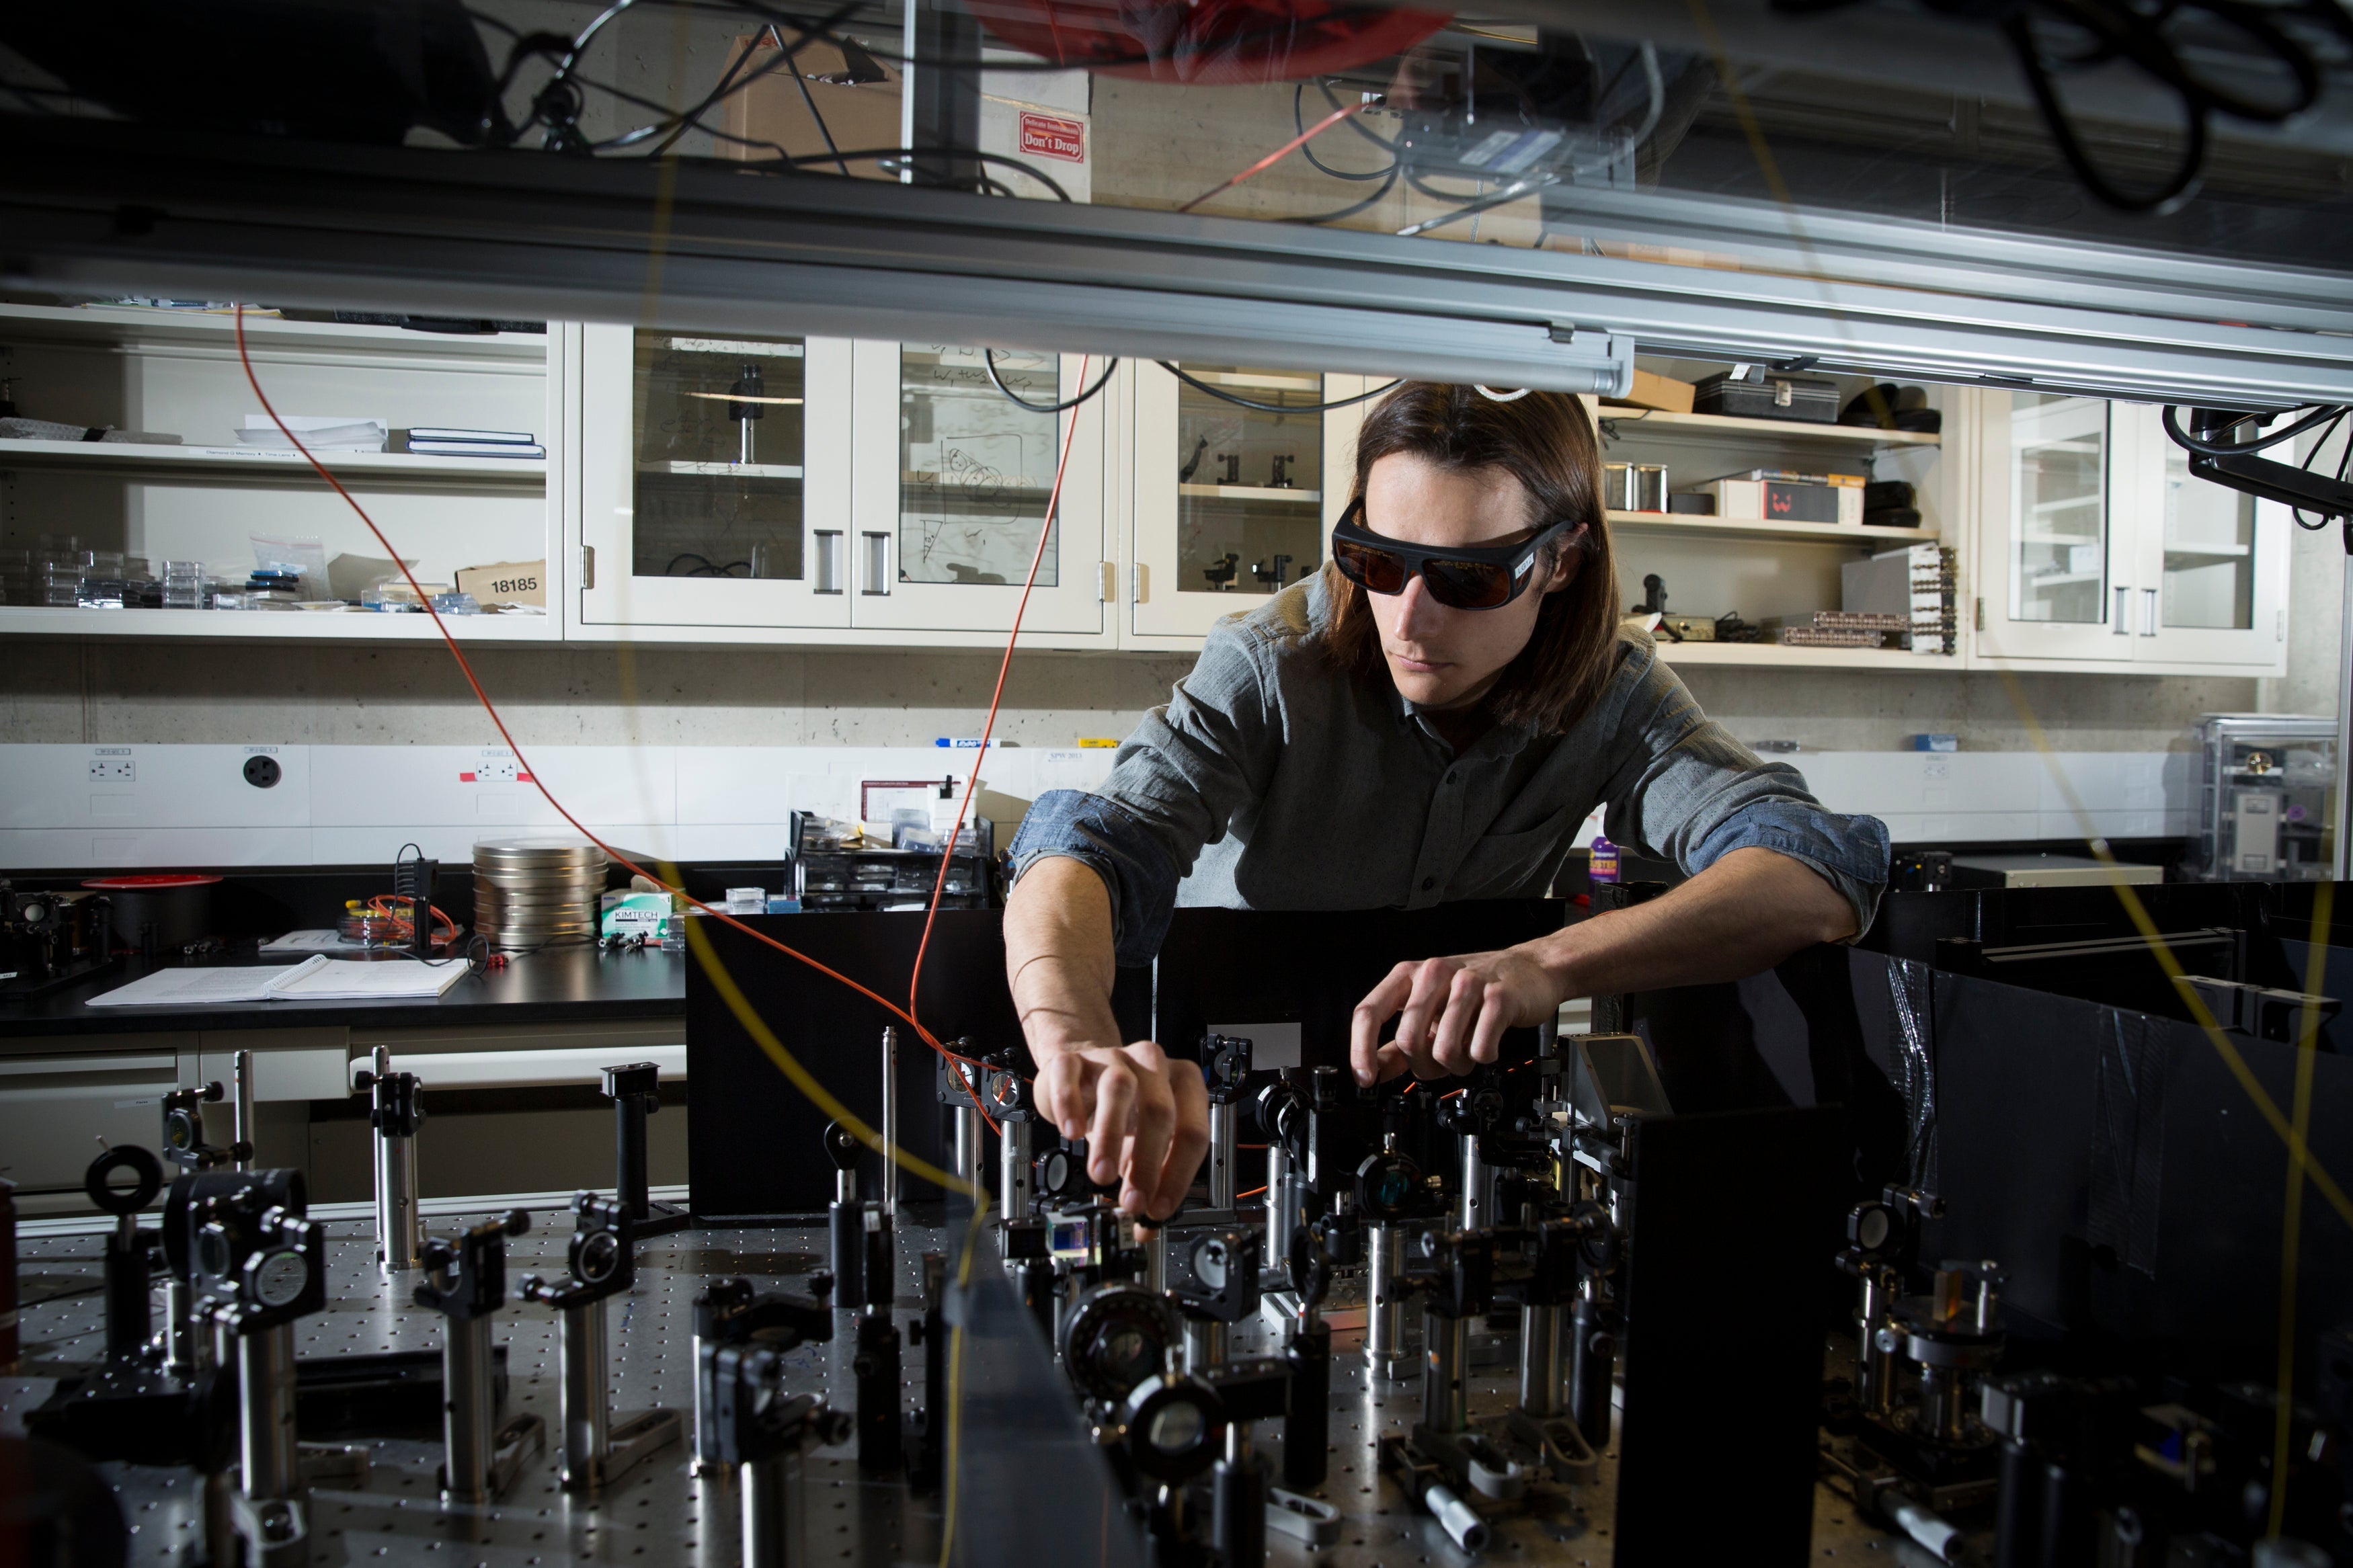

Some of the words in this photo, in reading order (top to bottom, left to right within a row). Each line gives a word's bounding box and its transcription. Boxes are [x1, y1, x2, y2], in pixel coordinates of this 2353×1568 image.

[1025, 132, 1053, 149] Don't
[1054, 138, 1079, 155] Drop
[491, 577, 537, 593] 18185
[1049, 752, 1066, 760] SPW
[1067, 752, 1082, 760] 2013
